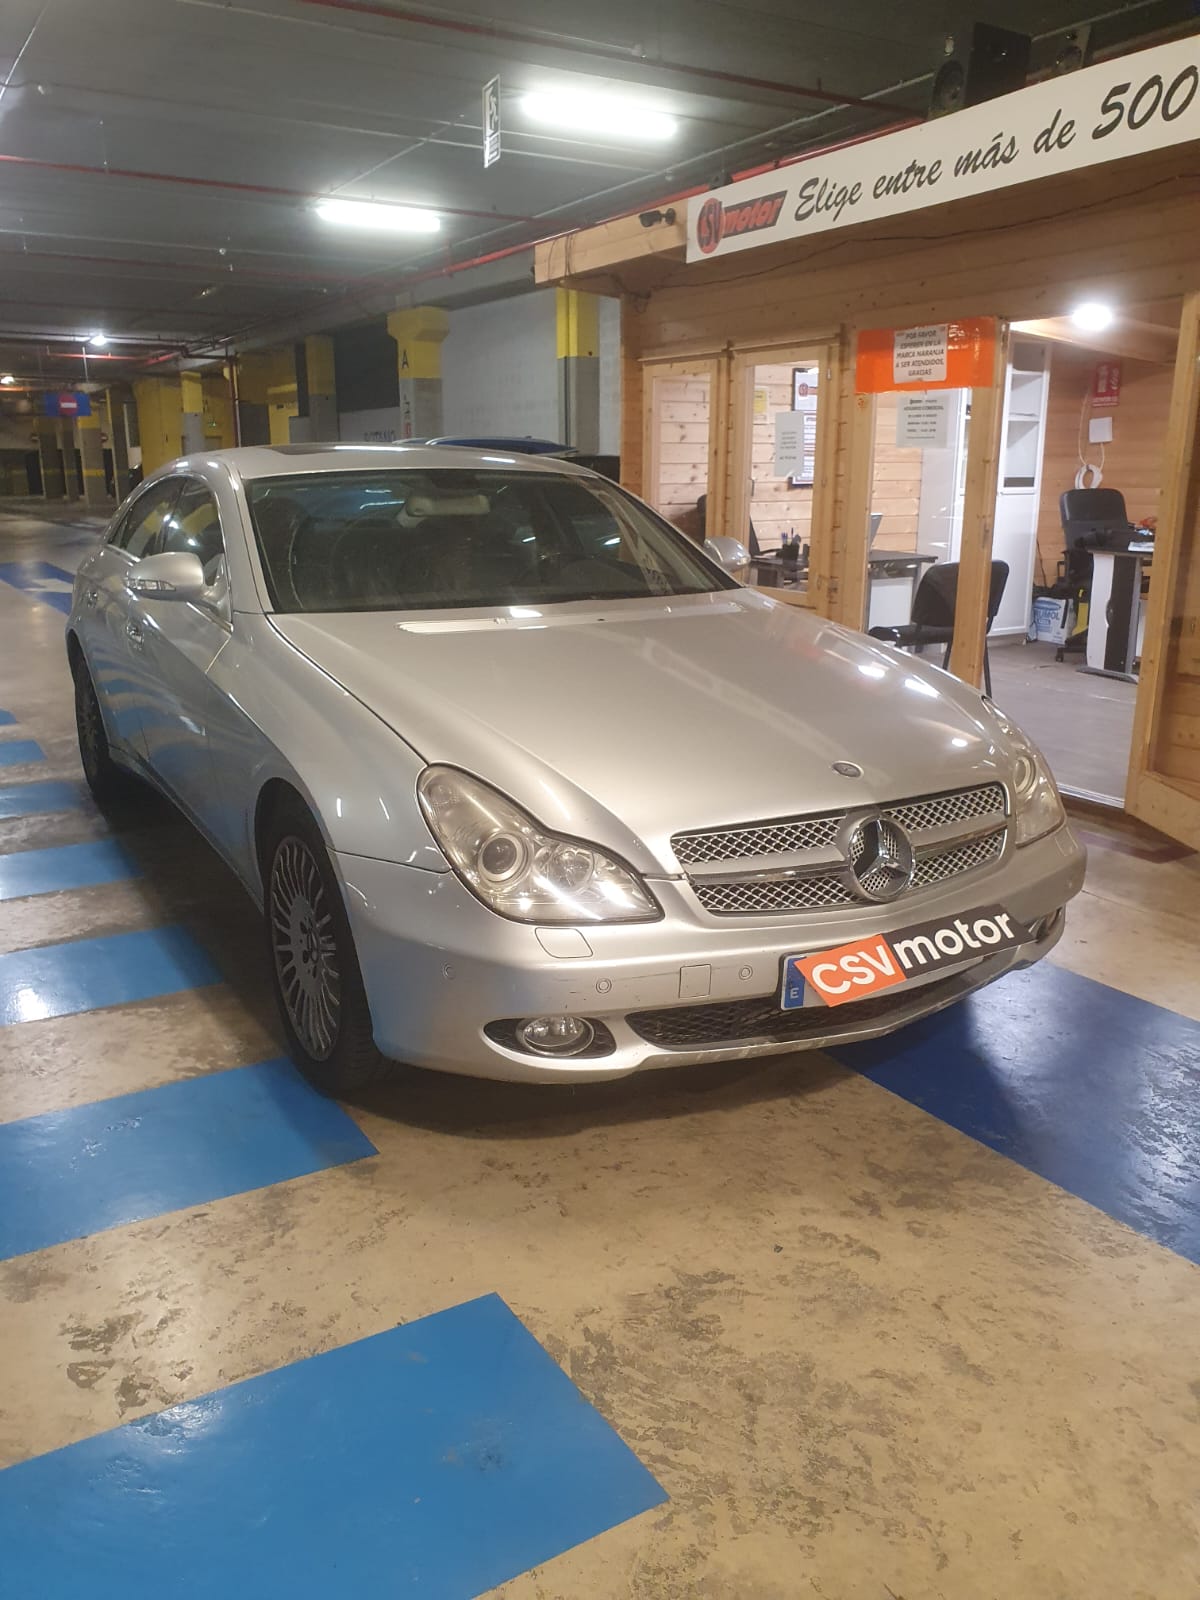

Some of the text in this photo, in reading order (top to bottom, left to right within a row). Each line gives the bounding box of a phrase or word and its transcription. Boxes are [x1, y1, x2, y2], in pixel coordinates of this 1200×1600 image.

[794, 65, 1199, 222] Elige entre más de 500
[724, 198, 783, 234] motor
[812, 913, 1014, 994] CSV motor
[790, 988, 799, 998] E
